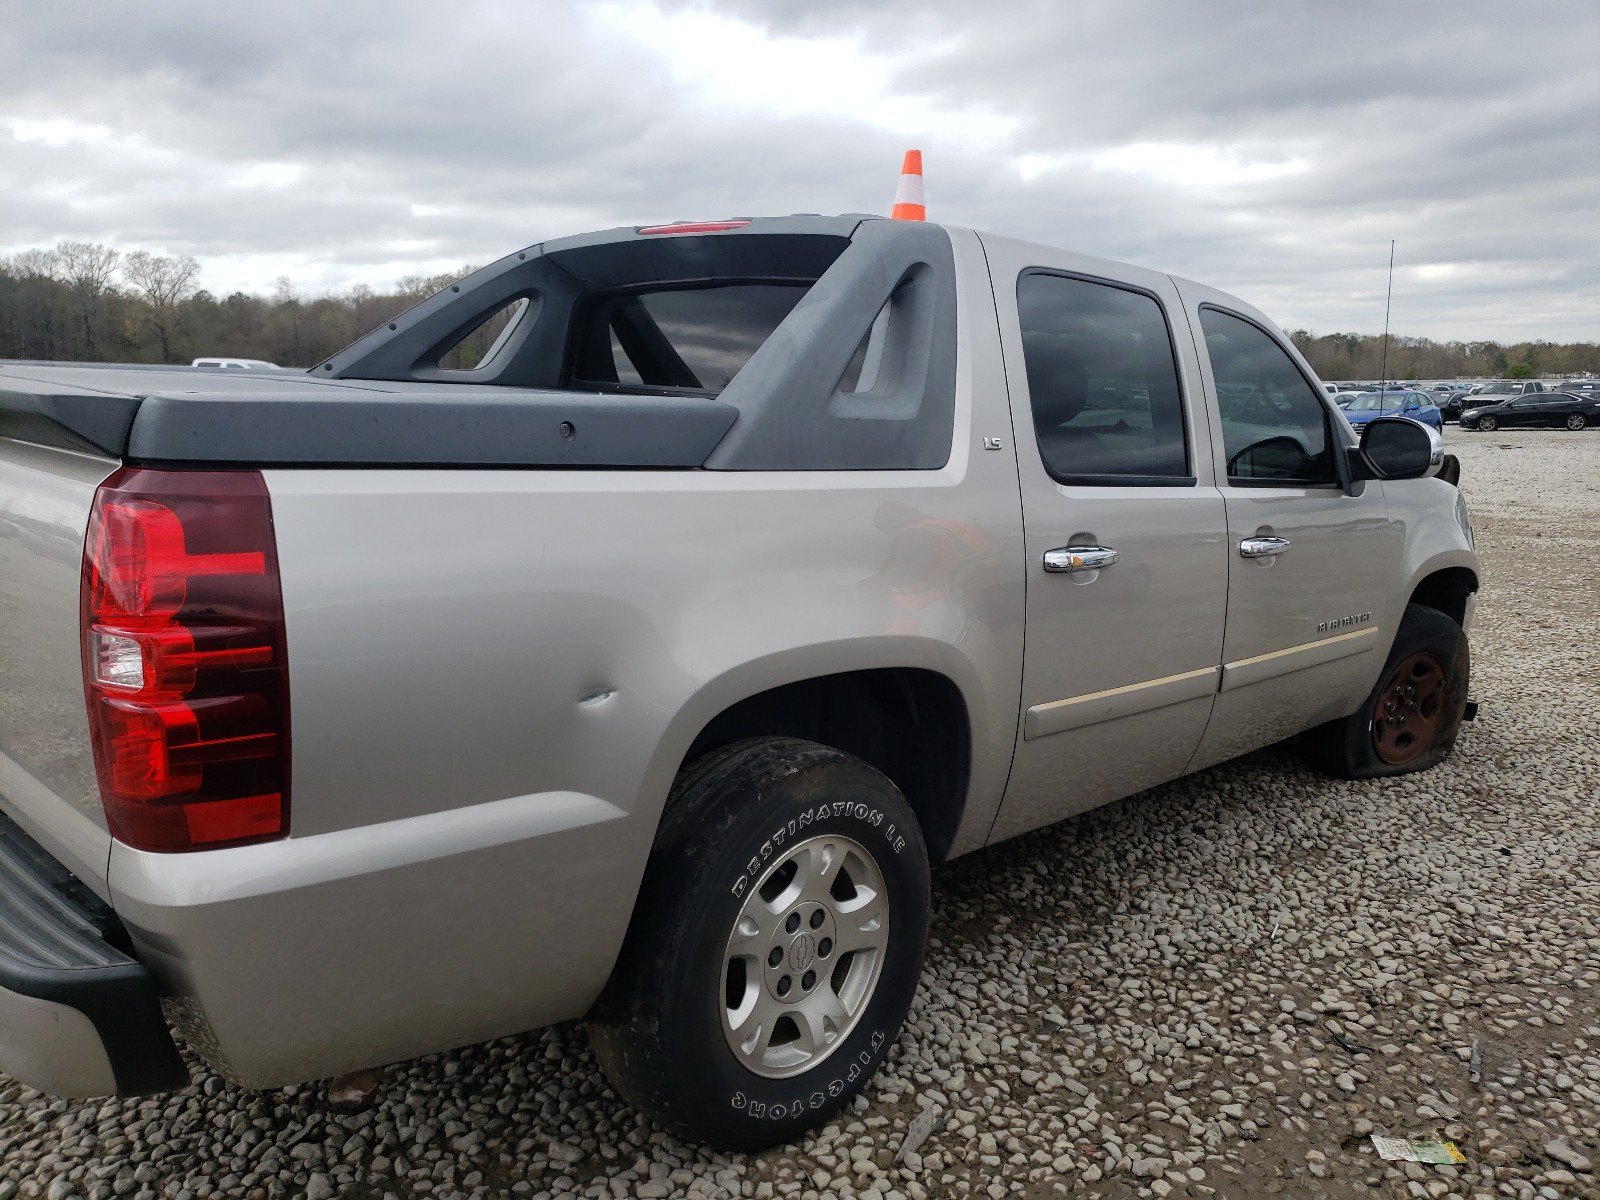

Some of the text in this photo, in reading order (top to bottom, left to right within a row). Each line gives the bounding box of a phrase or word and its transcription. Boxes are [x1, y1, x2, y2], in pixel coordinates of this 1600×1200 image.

[983, 437, 1001, 450] LS
[732, 801, 906, 898] DESTINATION LE
